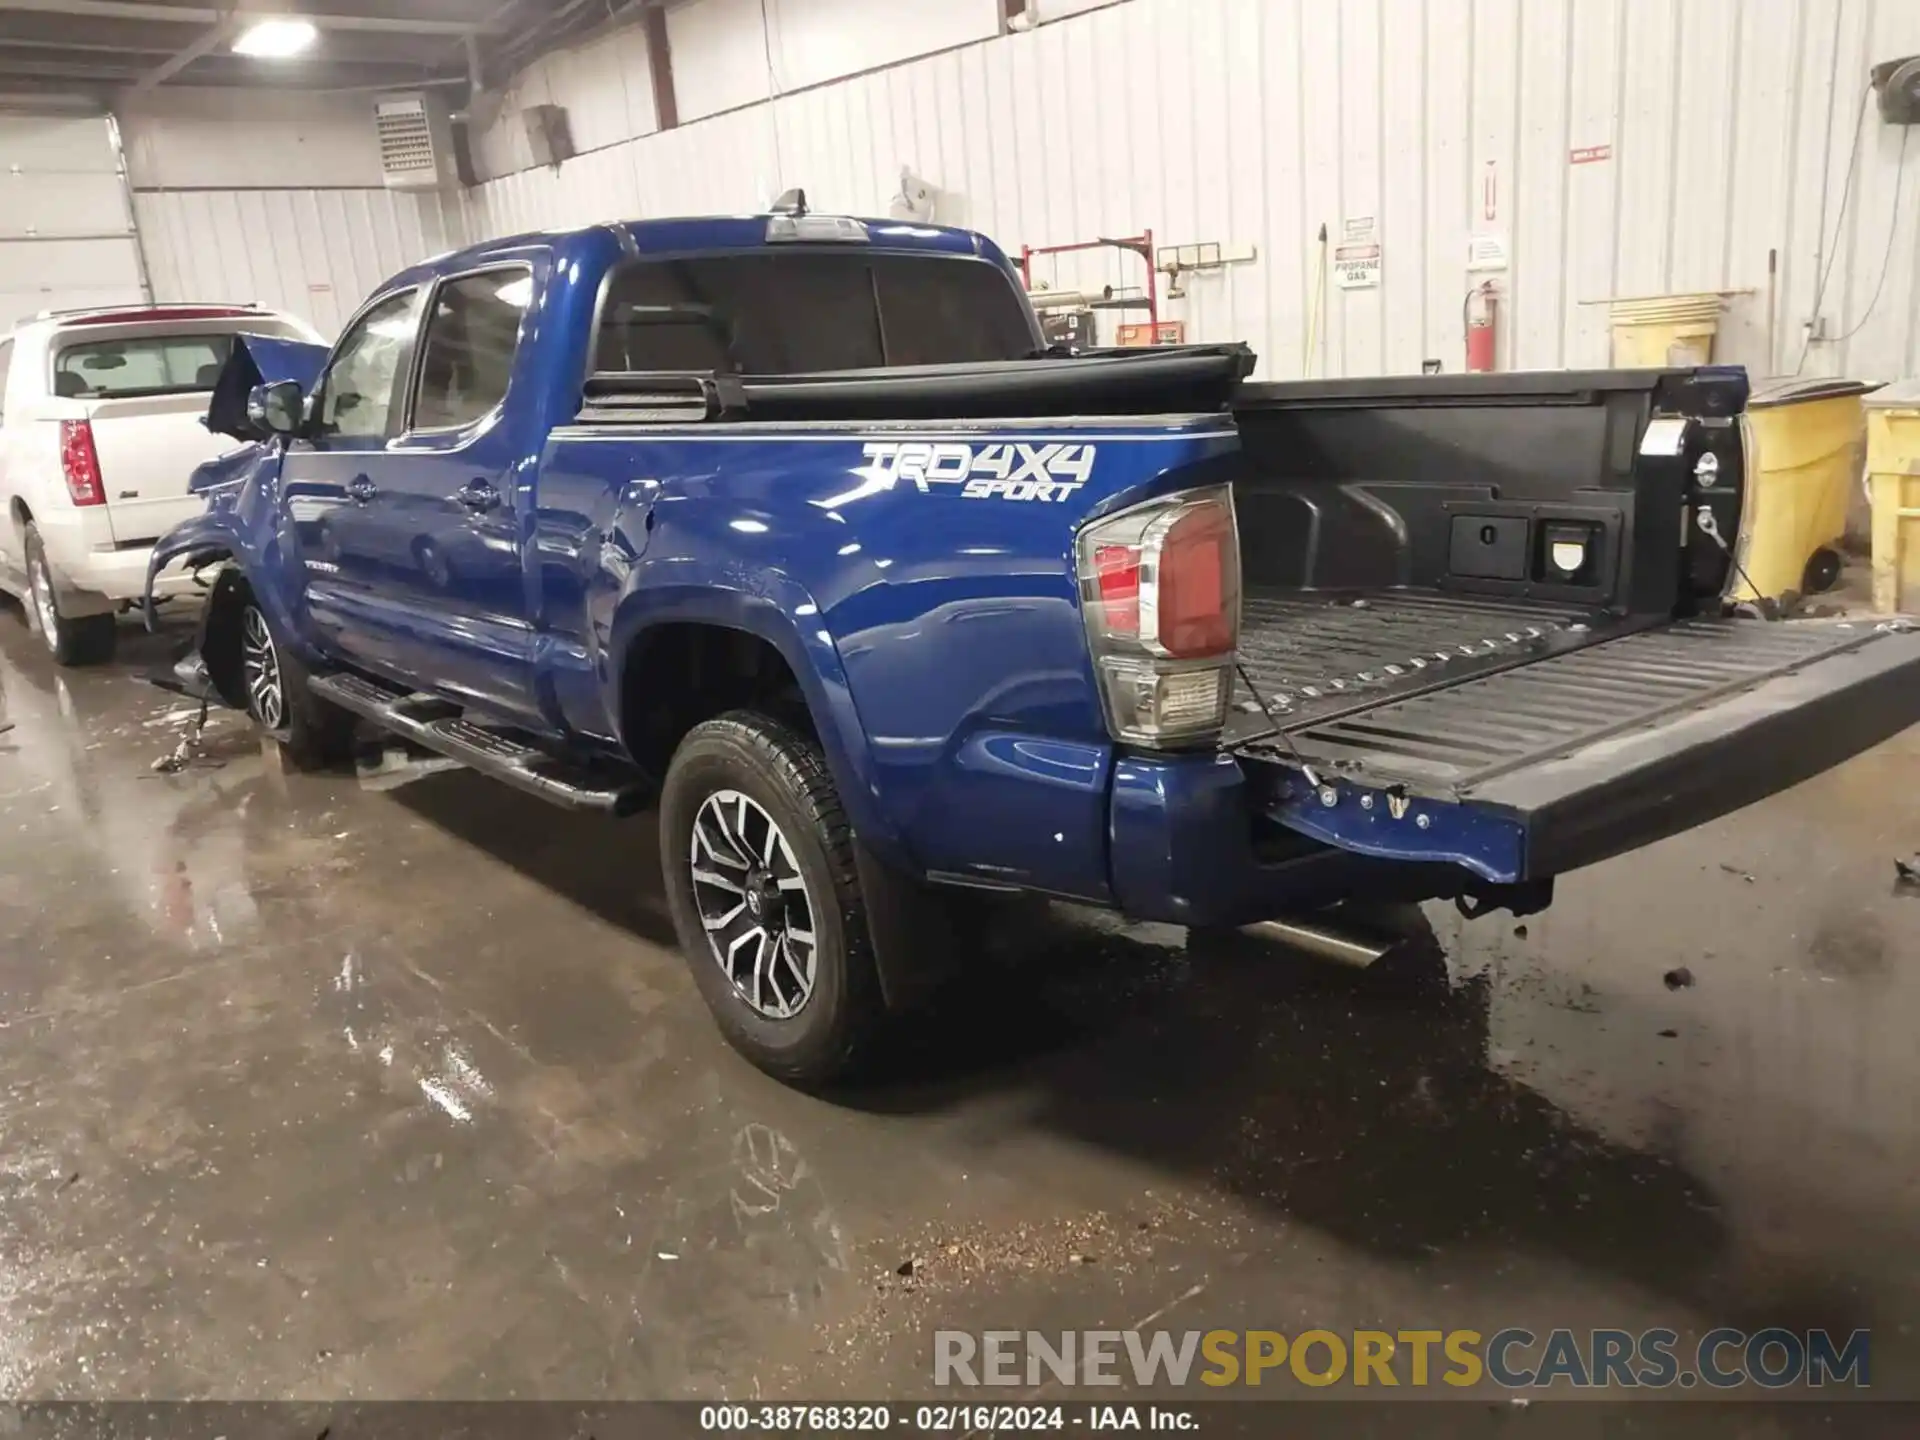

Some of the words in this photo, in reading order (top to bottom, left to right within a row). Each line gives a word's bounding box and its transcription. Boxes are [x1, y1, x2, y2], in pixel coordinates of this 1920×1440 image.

[1335, 260, 1379, 271] PROPANE
[1347, 271, 1366, 280] GAS
[863, 442, 972, 492] TRD
[961, 479, 1084, 502] SPORT
